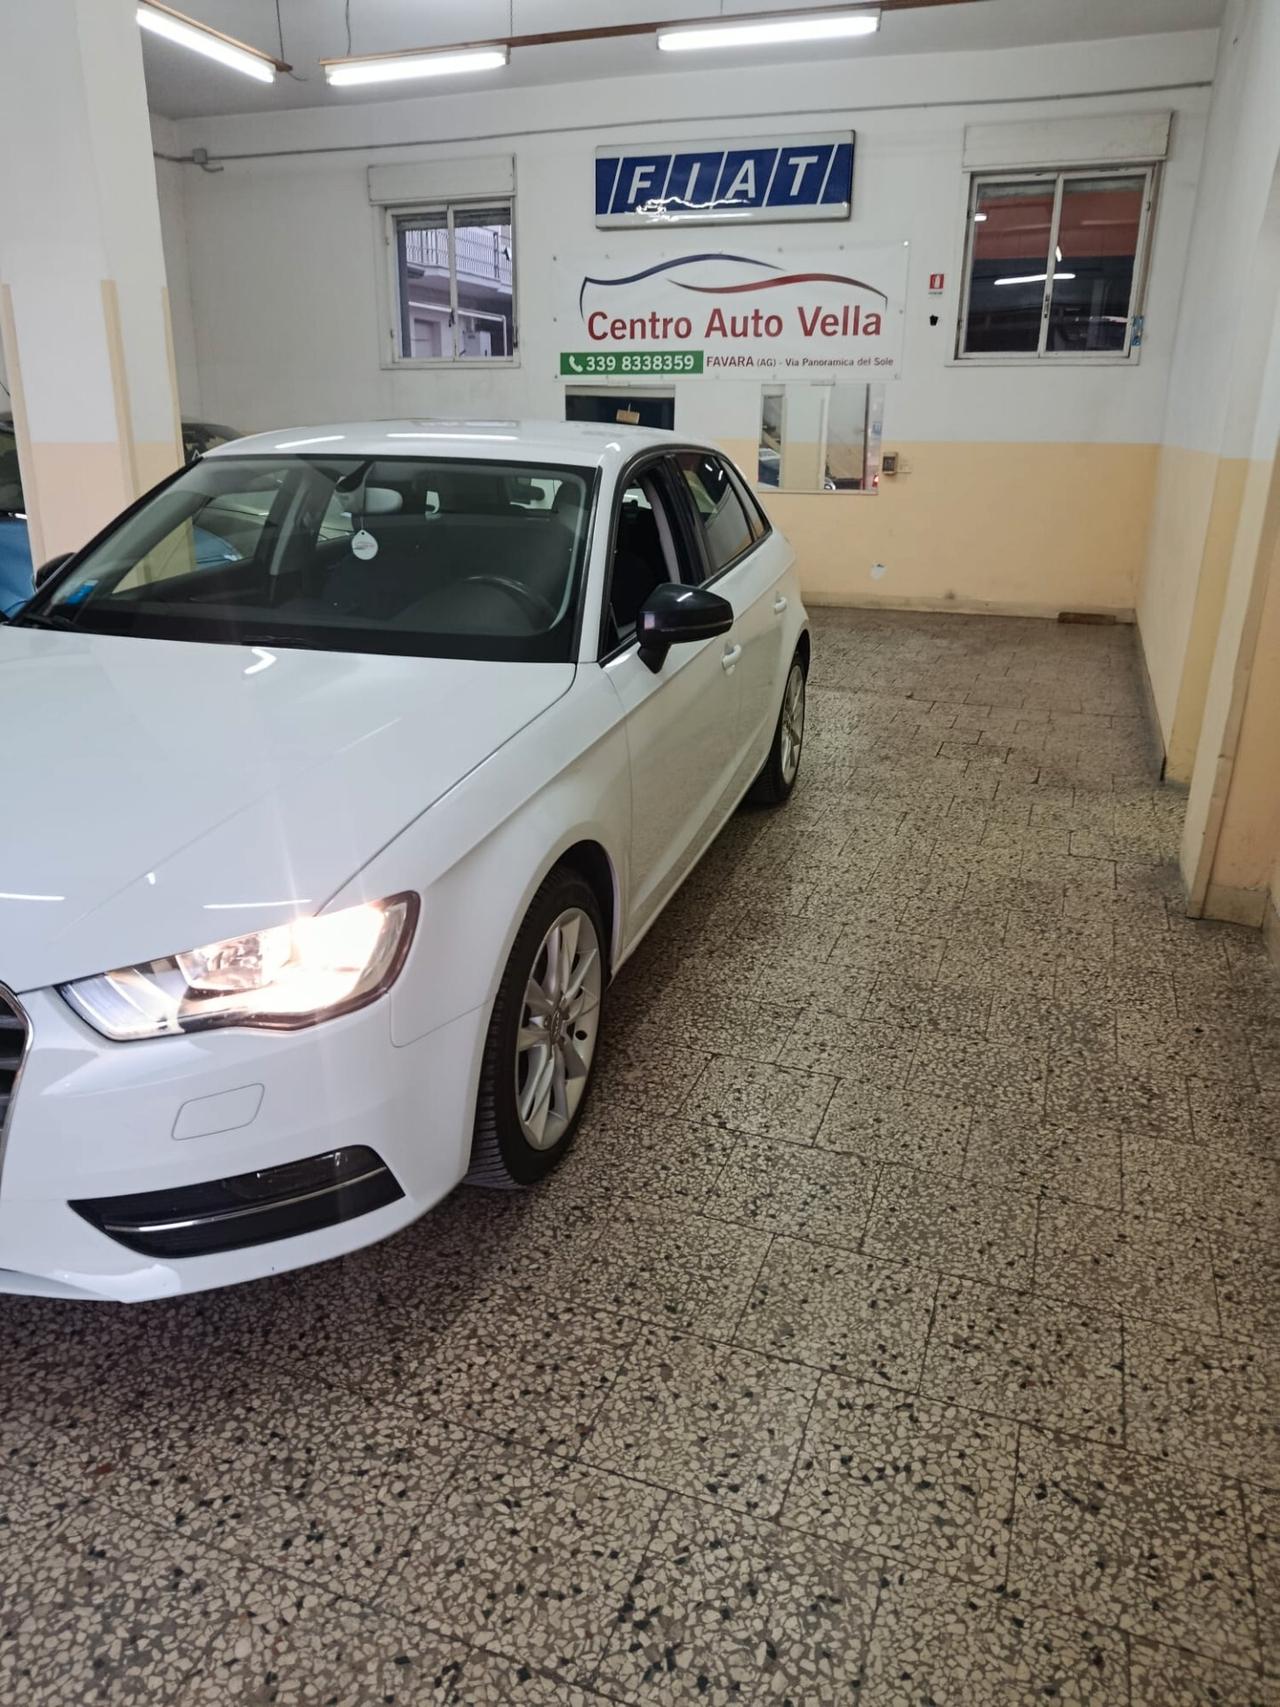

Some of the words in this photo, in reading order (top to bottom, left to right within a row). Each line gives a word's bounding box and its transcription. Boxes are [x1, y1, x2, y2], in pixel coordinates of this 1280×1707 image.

[627, 156, 818, 204] FIAT
[587, 311, 693, 341] Centro
[704, 308, 784, 339] Auto
[797, 304, 882, 337] Vella
[586, 355, 616, 371] 339
[621, 354, 695, 371] 8338359
[706, 356, 754, 367] FAVARA
[757, 358, 777, 368] (AG)
[785, 358, 799, 366] Via
[802, 357, 854, 367] Panoramica
[857, 357, 871, 367] del
[873, 357, 894, 366] Sole
